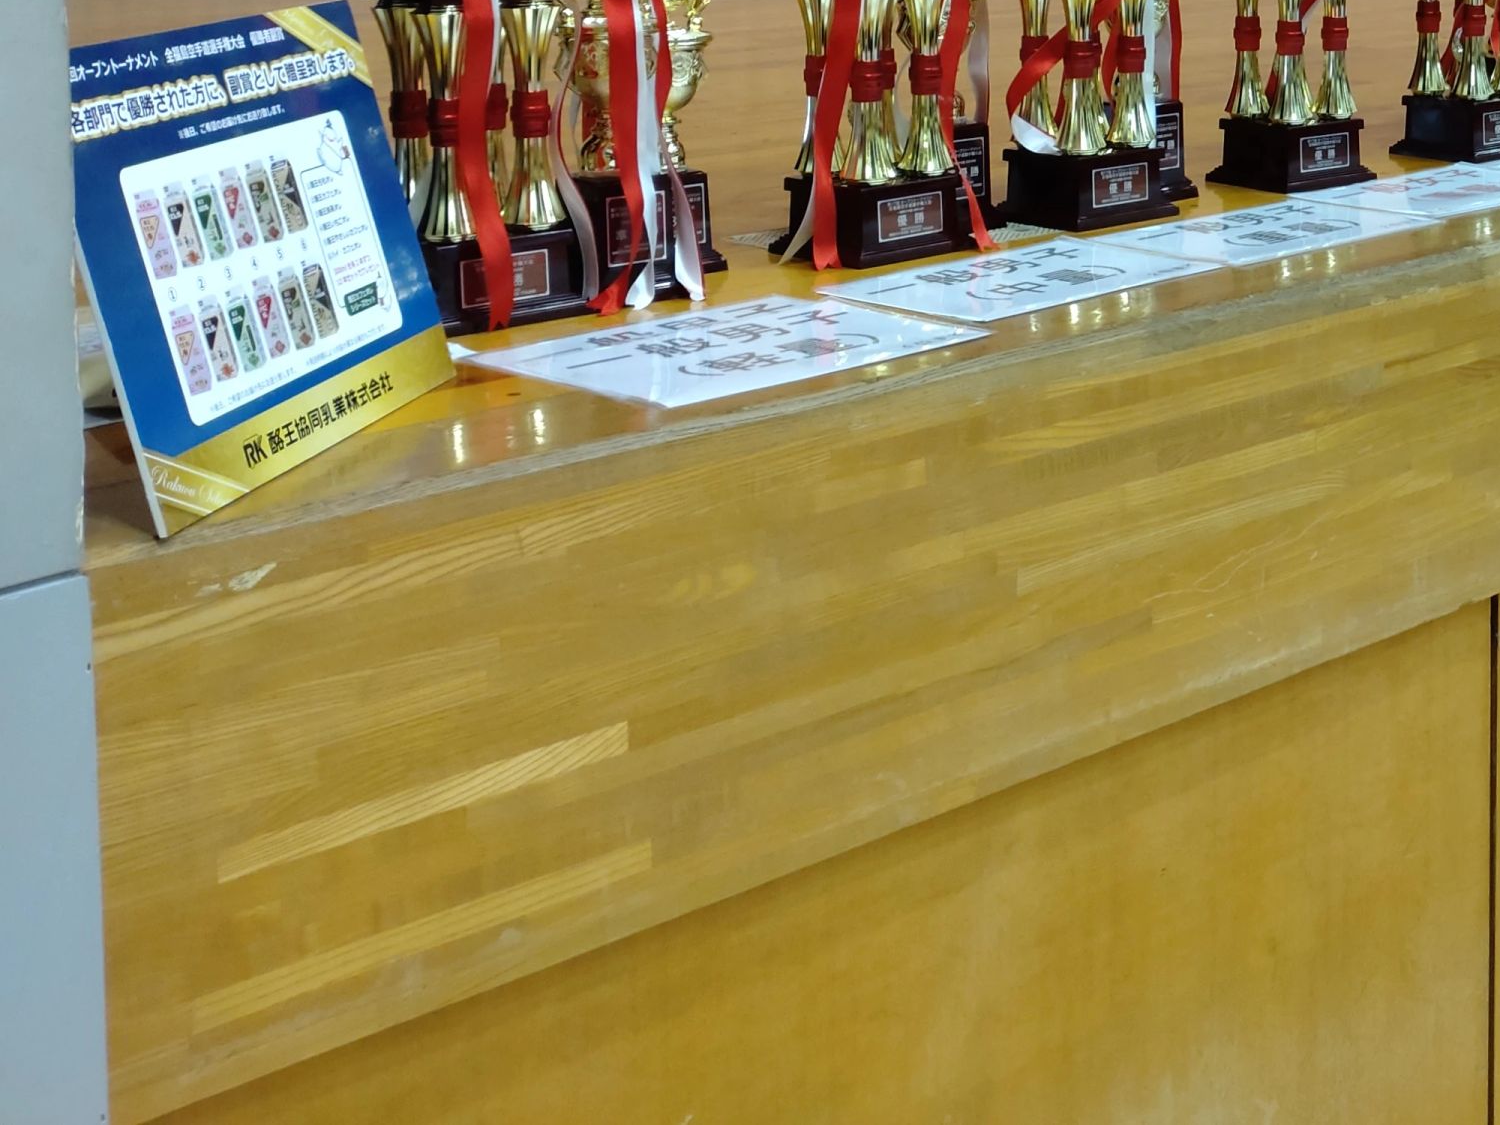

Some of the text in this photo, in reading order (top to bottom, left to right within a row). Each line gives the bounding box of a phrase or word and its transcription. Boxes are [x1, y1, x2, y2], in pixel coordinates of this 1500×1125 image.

[1138, 204, 1315, 241] 一般男子
[867, 246, 1080, 295] 一般男子
[966, 265, 1126, 301] (中量)
[566, 309, 848, 370] 一般男子
[678, 333, 879, 376] (軽量)
[268, 373, 394, 455] 酪王協同乳業株式会社
